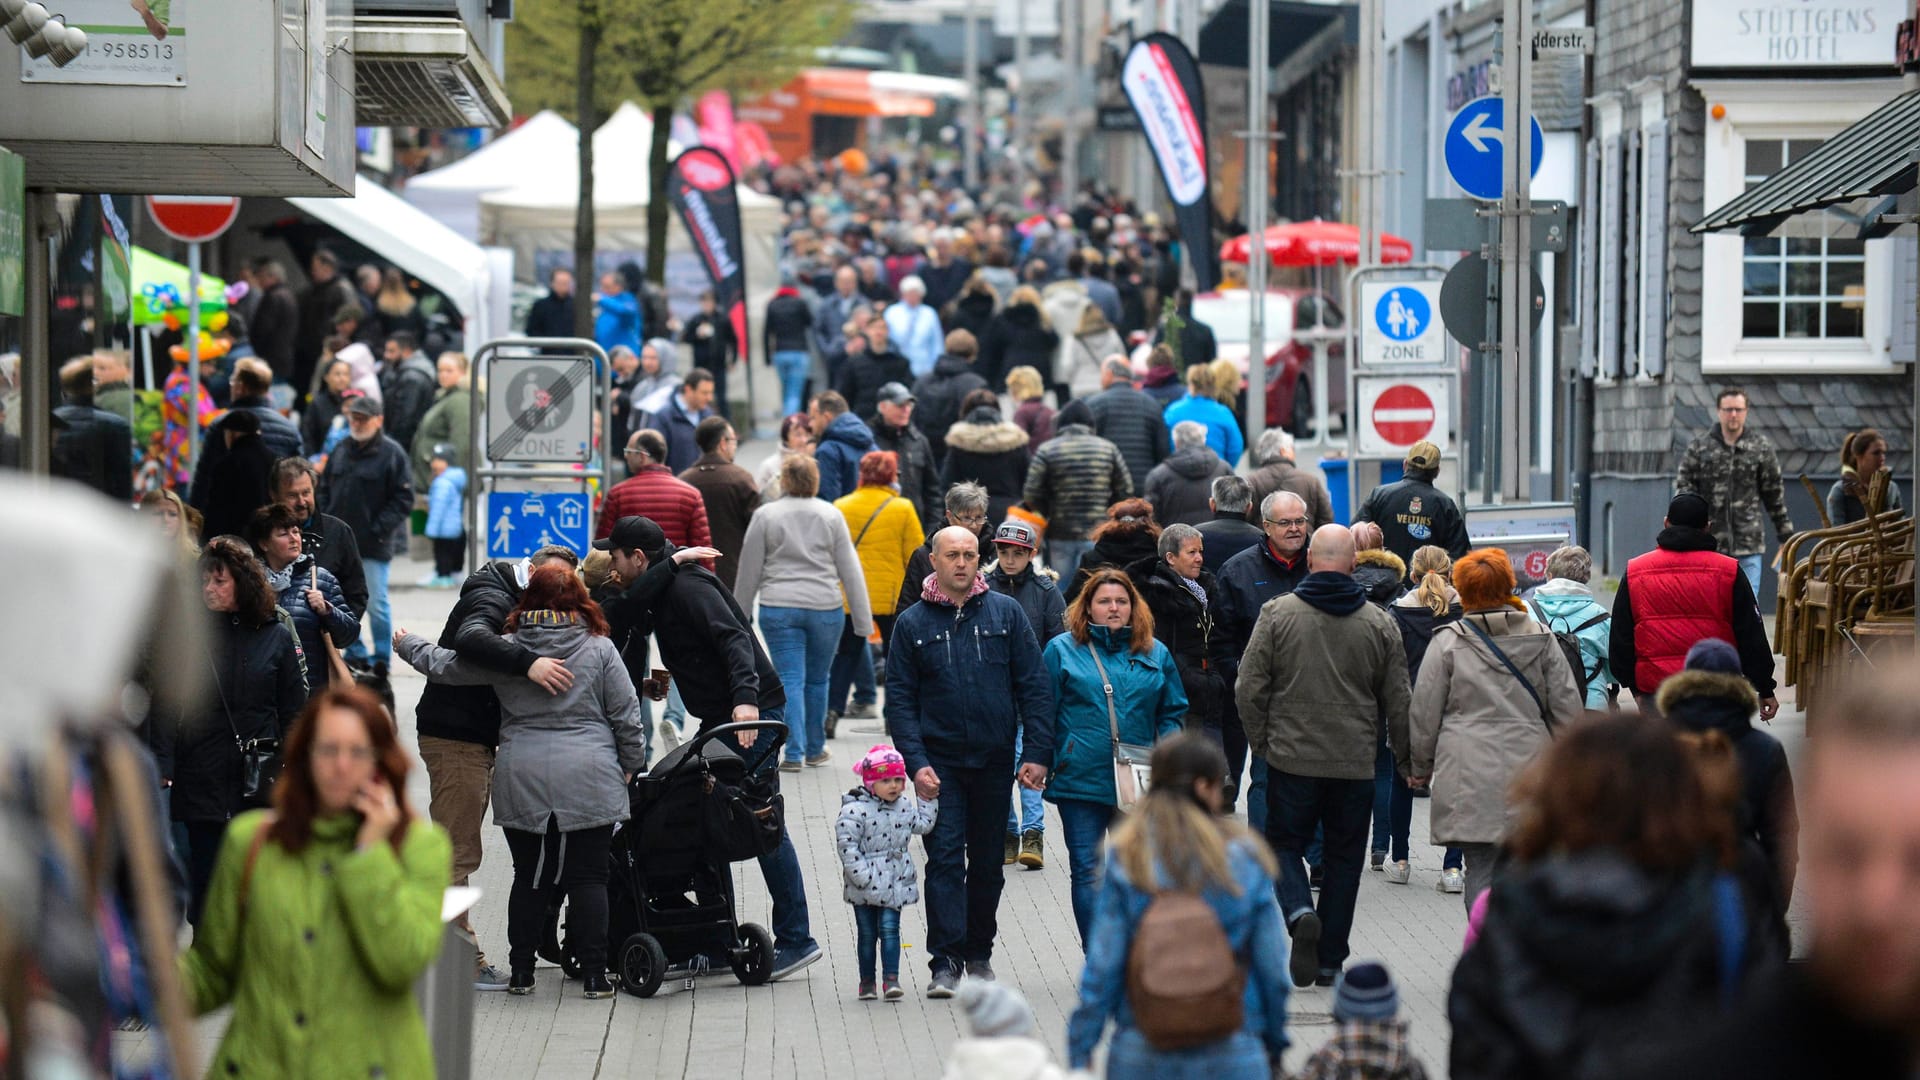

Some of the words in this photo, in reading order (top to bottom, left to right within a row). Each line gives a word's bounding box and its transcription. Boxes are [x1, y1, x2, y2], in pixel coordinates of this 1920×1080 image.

[1738, 6, 1876, 35] STÜTTGENS
[1768, 36, 1840, 61] HOTEL
[1382, 345, 1425, 360] ZONE
[513, 439, 566, 456] ZONE
[1396, 513, 1432, 526] VELTINS
[1531, 556, 1544, 574] 5
